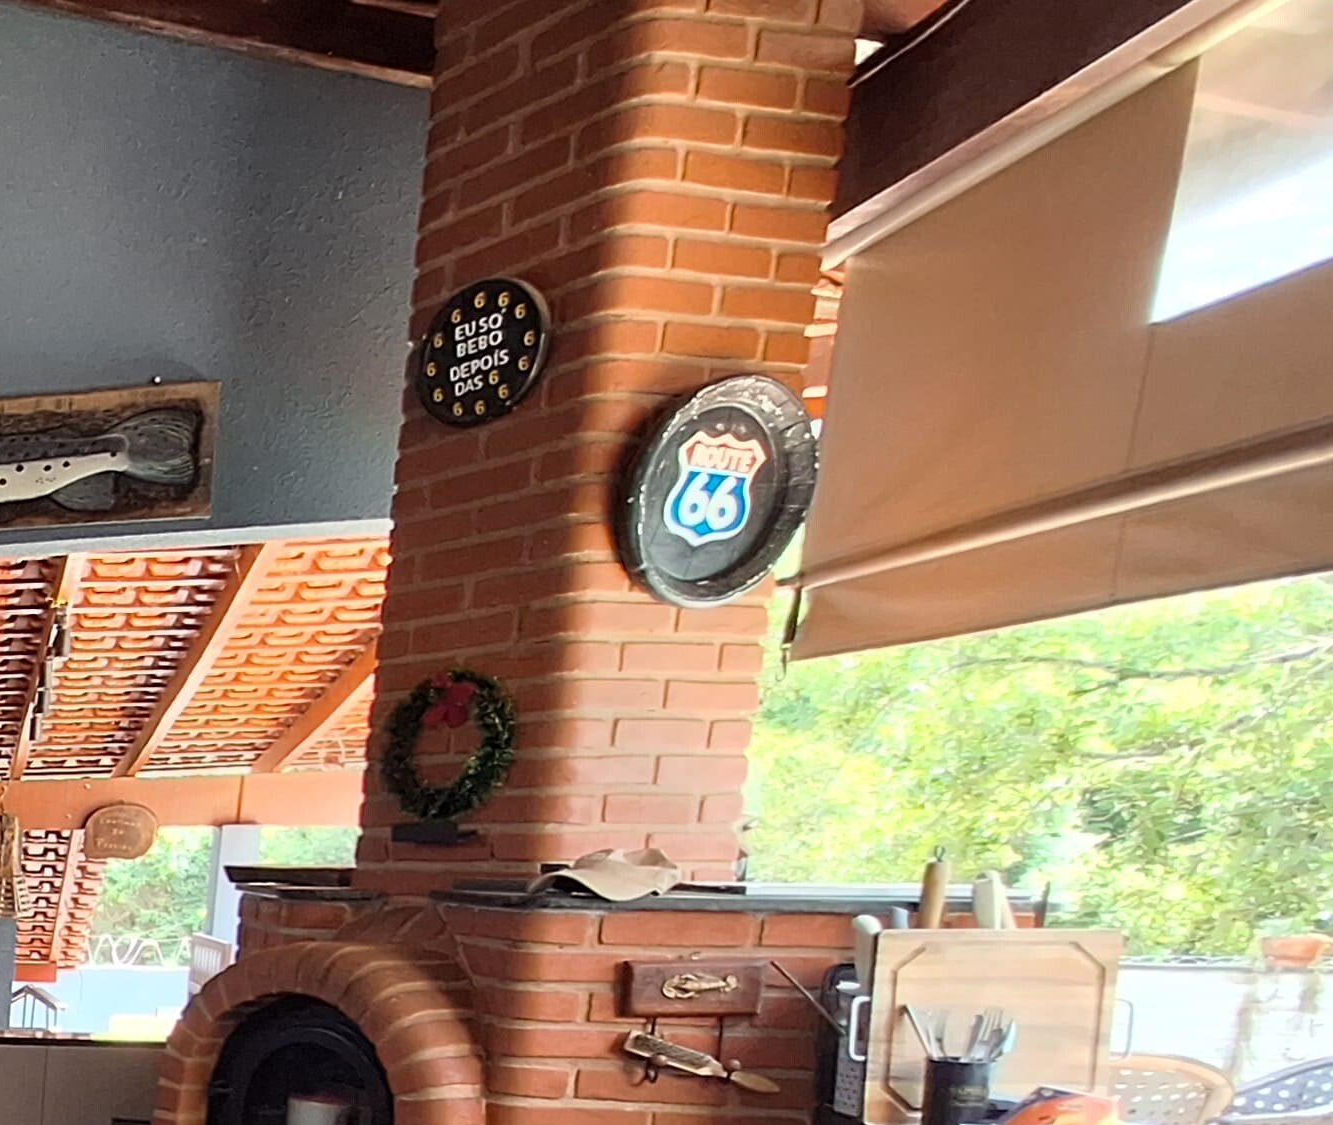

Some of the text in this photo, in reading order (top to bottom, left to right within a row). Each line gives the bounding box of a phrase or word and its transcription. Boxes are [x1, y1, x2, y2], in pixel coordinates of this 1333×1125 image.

[474, 292, 485, 308] 6
[498, 292, 509, 307] 6
[451, 309, 461, 323] 6
[515, 303, 525, 319] 6
[454, 308, 507, 341] EU SÓ
[433, 333, 443, 348] 6
[456, 330, 503, 358] BEBO
[524, 331, 535, 346] 6
[427, 362, 437, 377] 6
[518, 356, 529, 371] 6
[454, 370, 500, 397] DAS 6
[433, 388, 444, 402] 6
[498, 384, 509, 399] 6
[453, 402, 463, 416] 6
[475, 400, 485, 415] 6
[689, 443, 755, 474] ROUTE
[678, 472, 737, 531] 66
